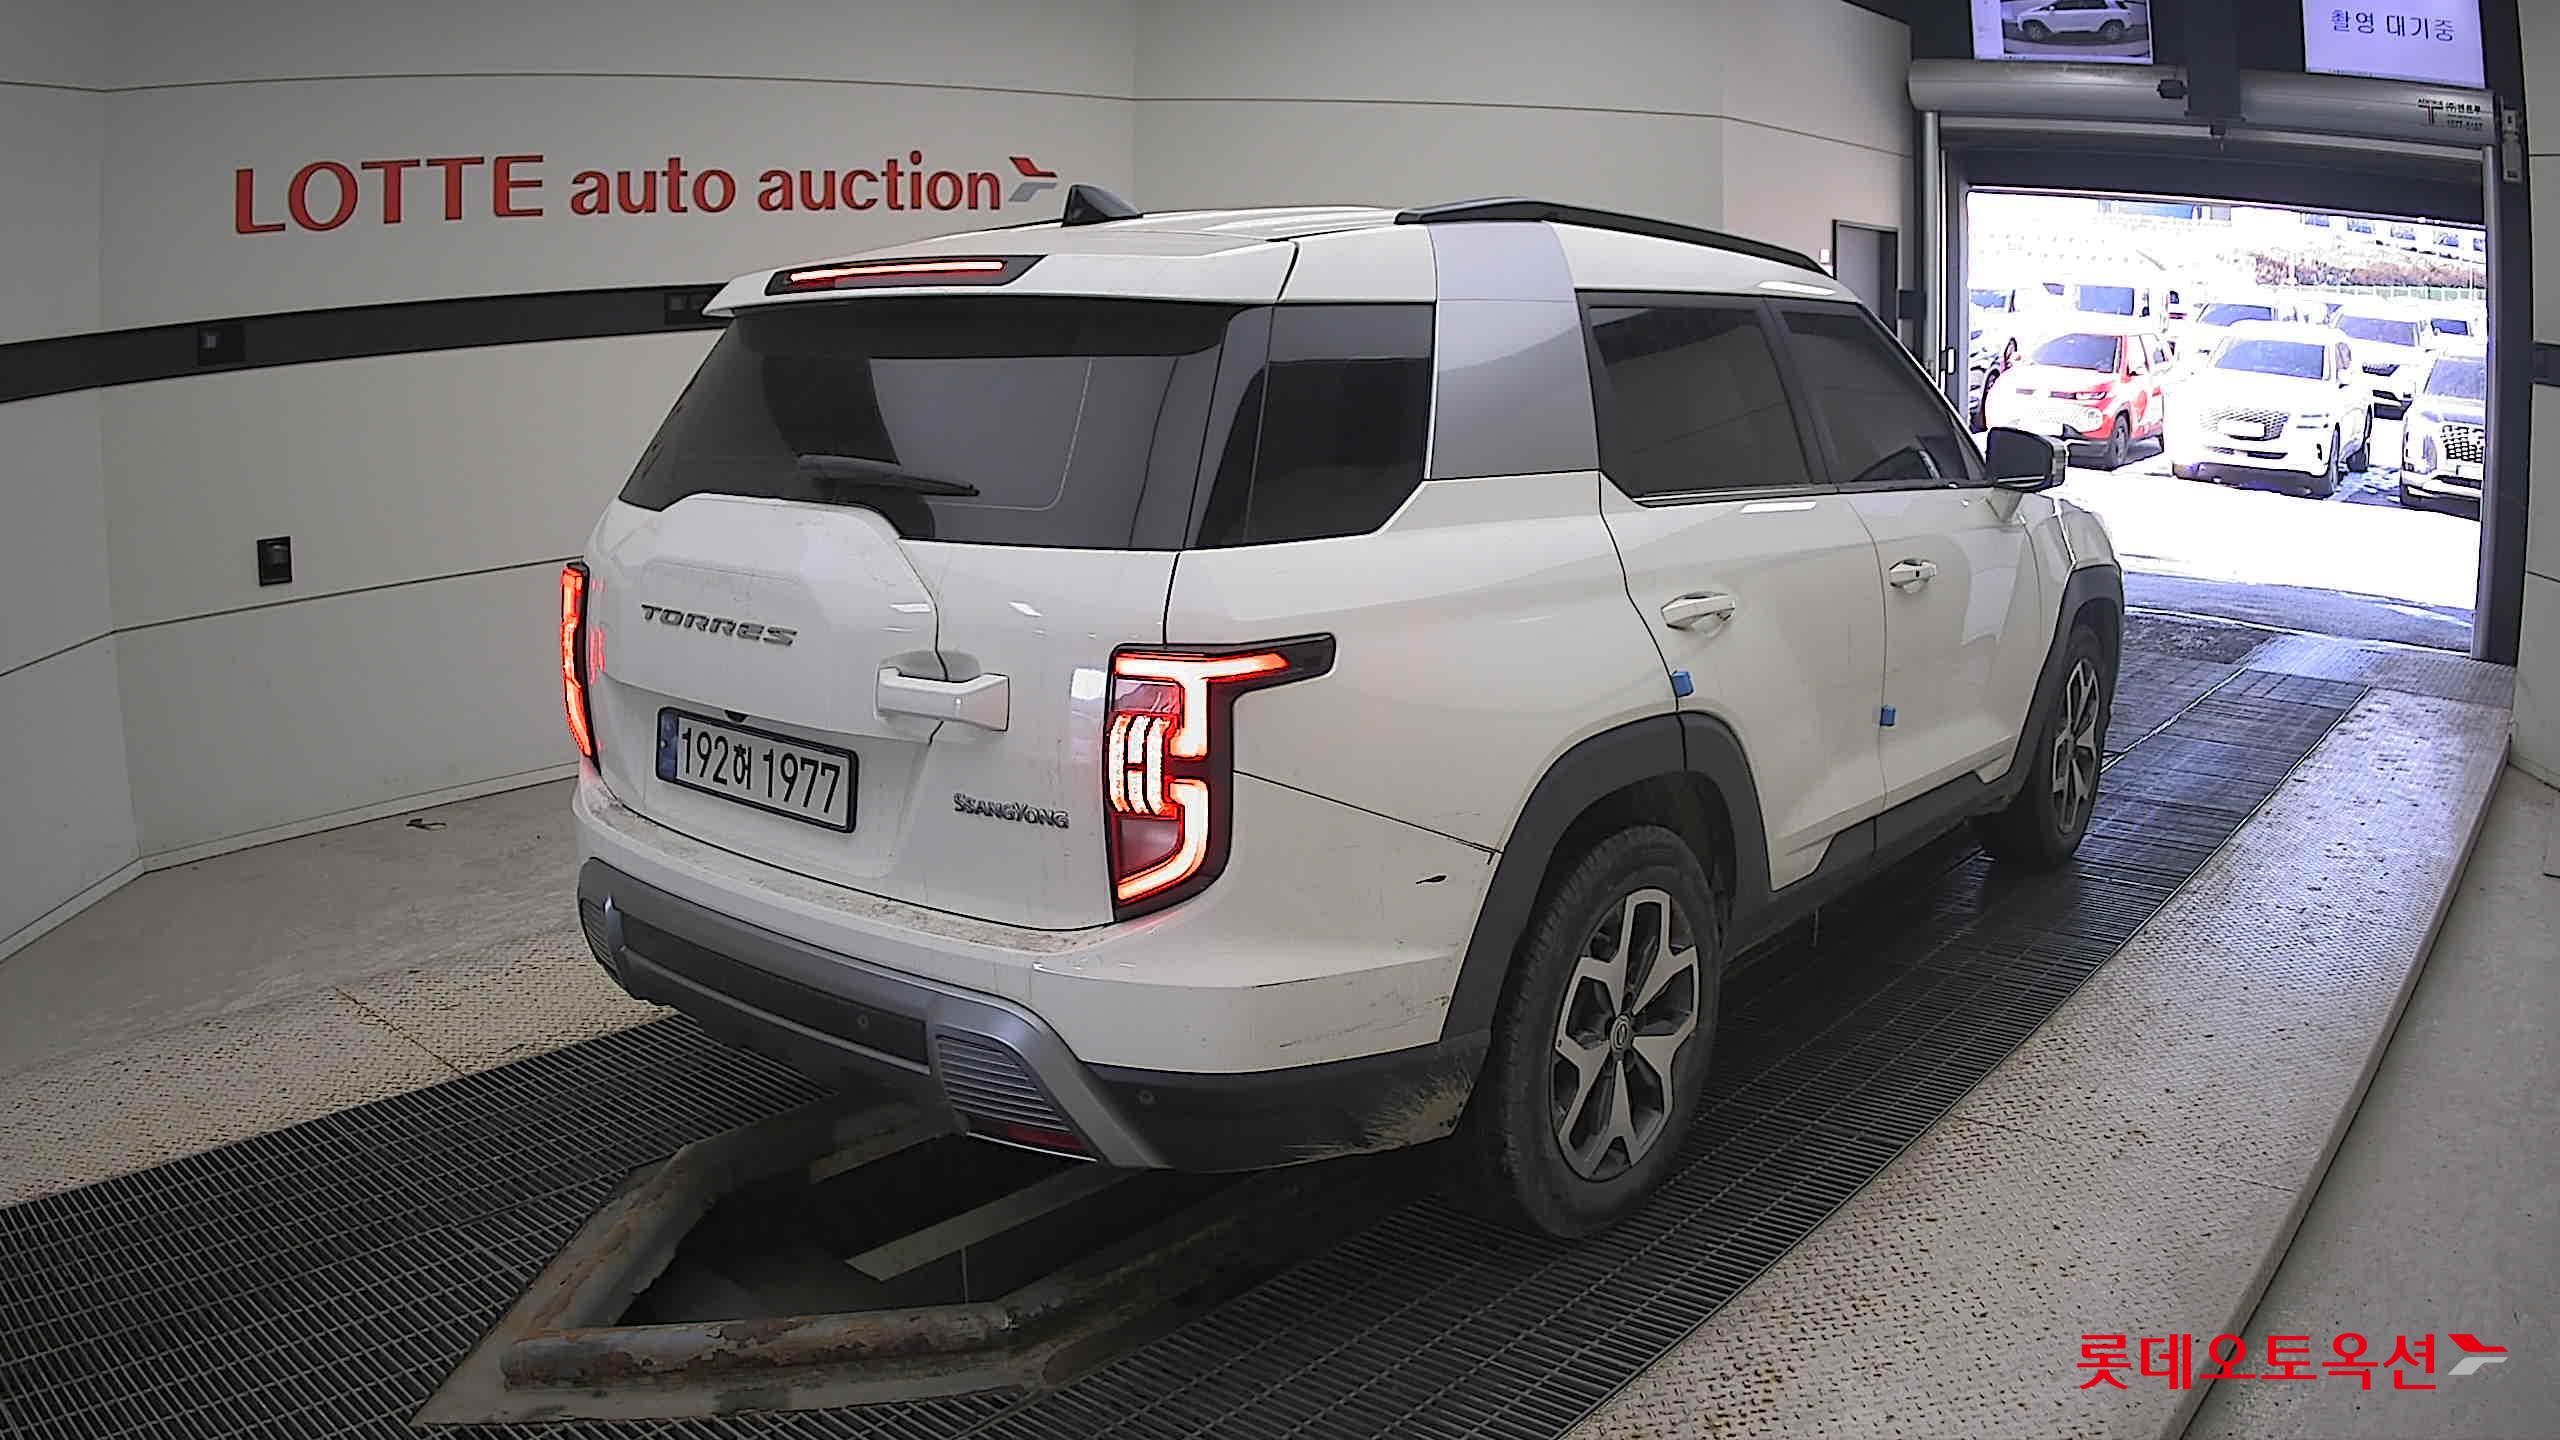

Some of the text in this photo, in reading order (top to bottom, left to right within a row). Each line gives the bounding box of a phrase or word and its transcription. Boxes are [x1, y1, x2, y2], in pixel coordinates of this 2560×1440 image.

[2331, 9, 2454, 41] 촬영 대기중
[236, 150, 1001, 234] LOTTE auto auction
[641, 603, 798, 646] TORRES
[681, 727, 841, 814] 192허 1977
